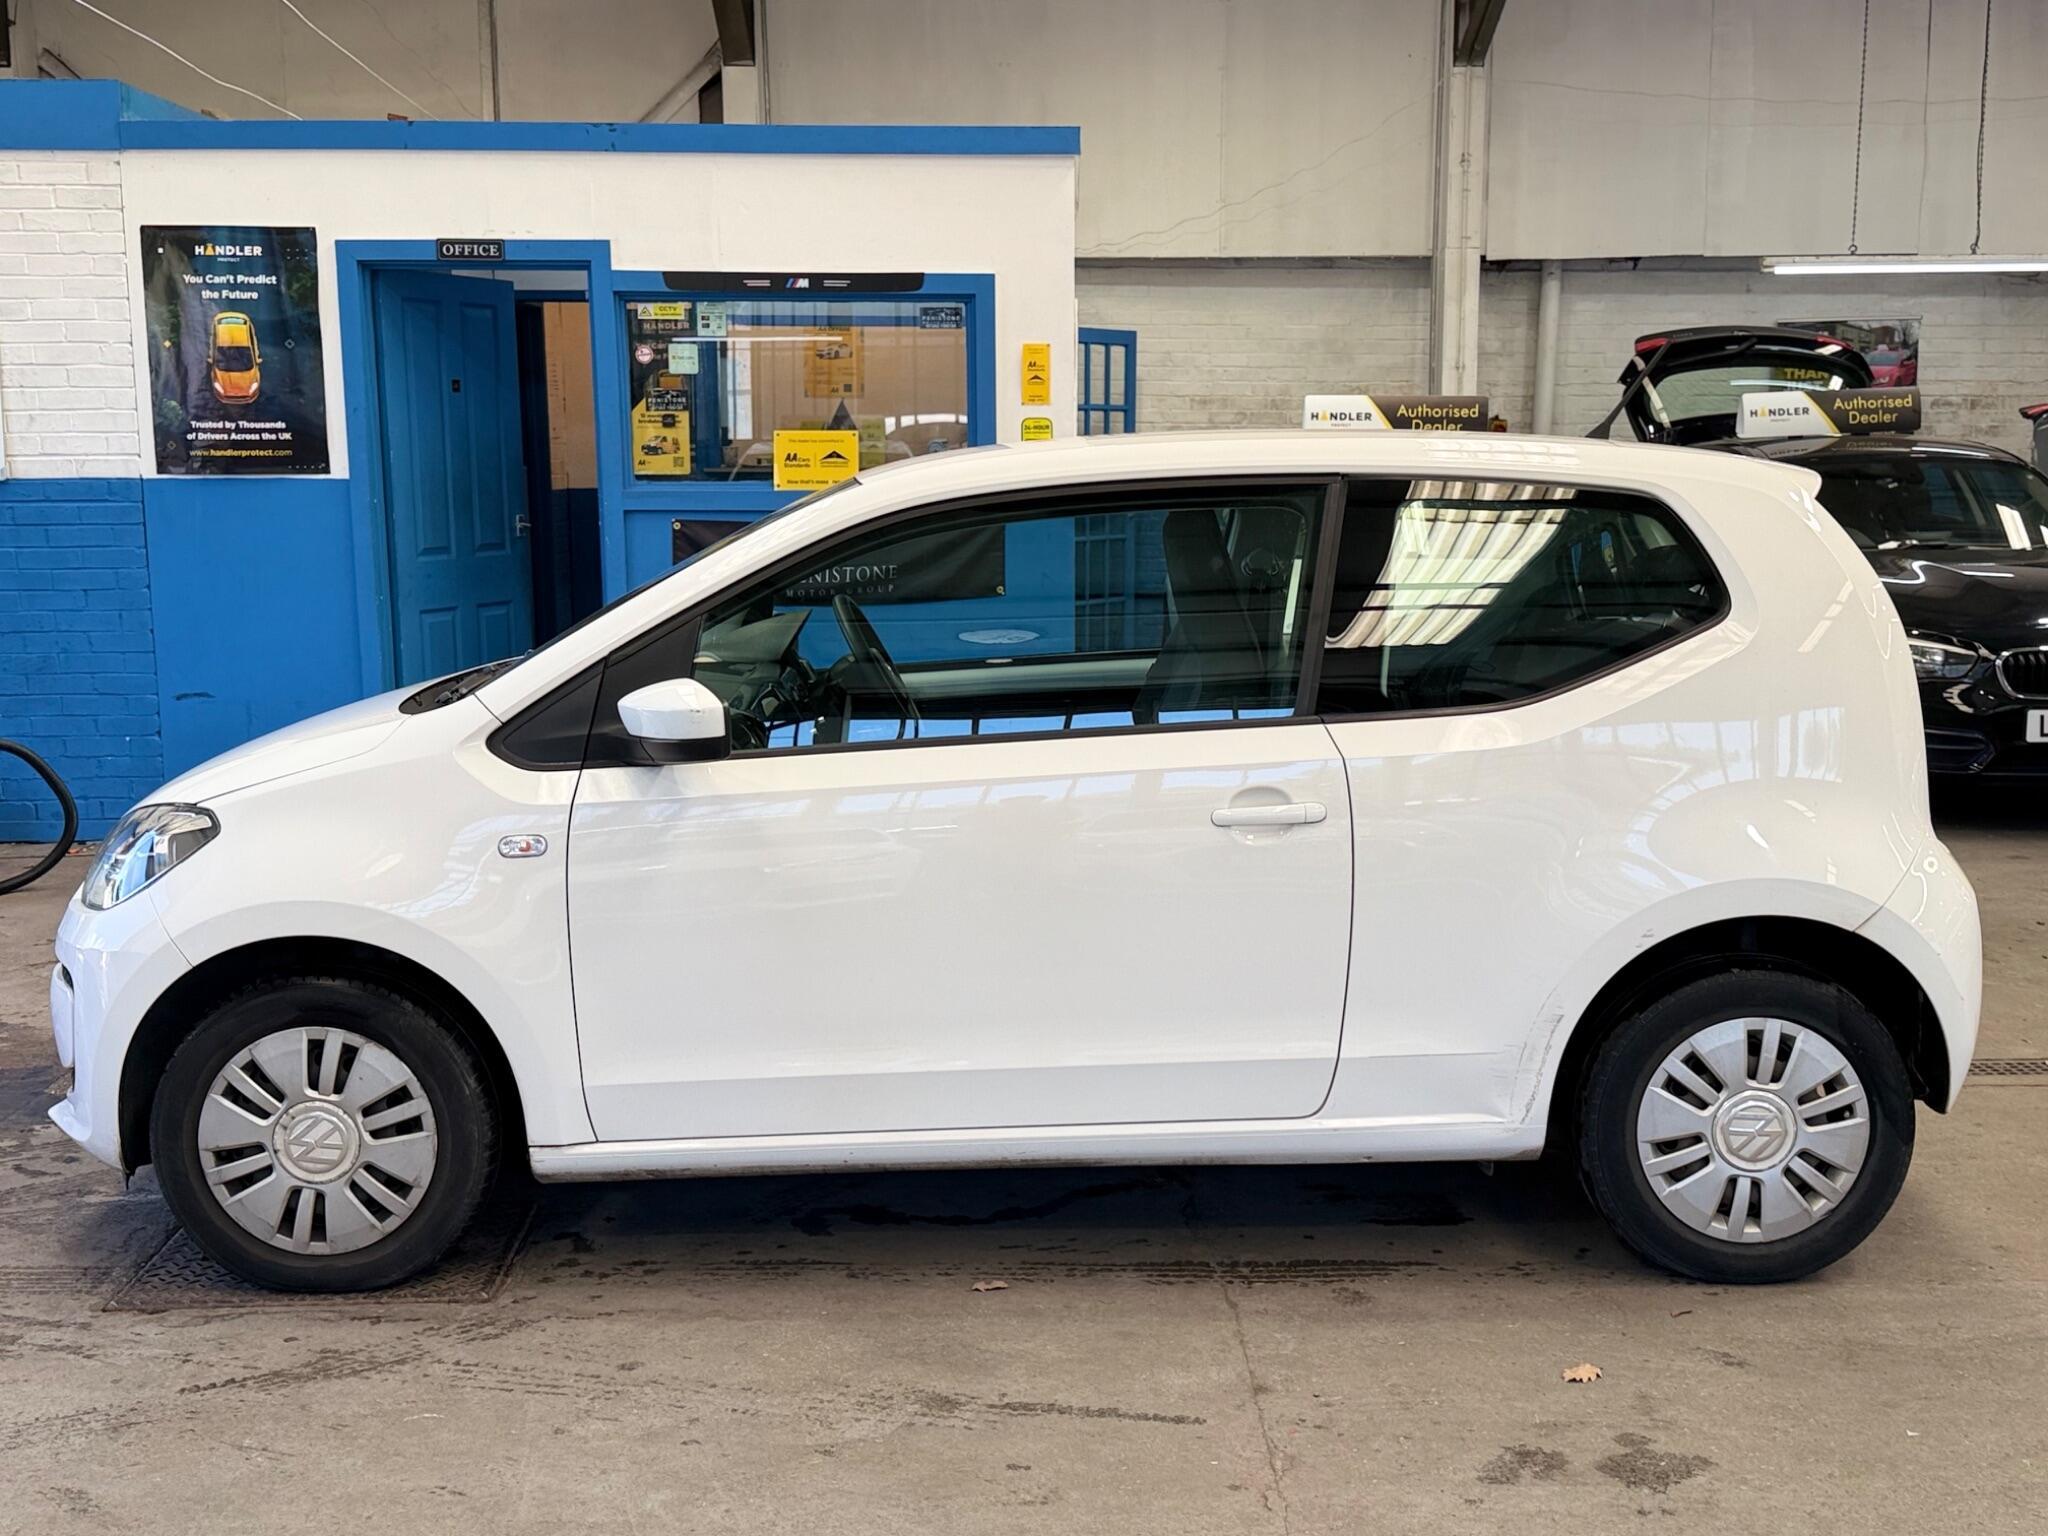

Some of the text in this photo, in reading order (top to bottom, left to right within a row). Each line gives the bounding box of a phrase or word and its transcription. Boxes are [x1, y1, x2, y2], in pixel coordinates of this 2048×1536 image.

[194, 244, 262, 256] HANDLER
[442, 243, 500, 256] OFFICE
[183, 274, 277, 285] You Can't Predict
[201, 289, 259, 300] the Future
[643, 321, 690, 330] HANDLER
[1833, 394, 1913, 411] Authorised
[1310, 409, 1372, 421] HANDLER
[1396, 403, 1480, 418] Authorised
[1749, 404, 1810, 418] HANDLER
[1848, 410, 1899, 425] Dealer
[190, 421, 287, 430] Trusted by Thousands
[1411, 419, 1463, 431] Dealer
[186, 432, 293, 440] of Drivers Across the UK
[189, 448, 293, 458] www.handlerprotect.com
[784, 452, 798, 462] AA
[800, 564, 898, 584] NISTONE
[785, 588, 836, 598] MOTOR
